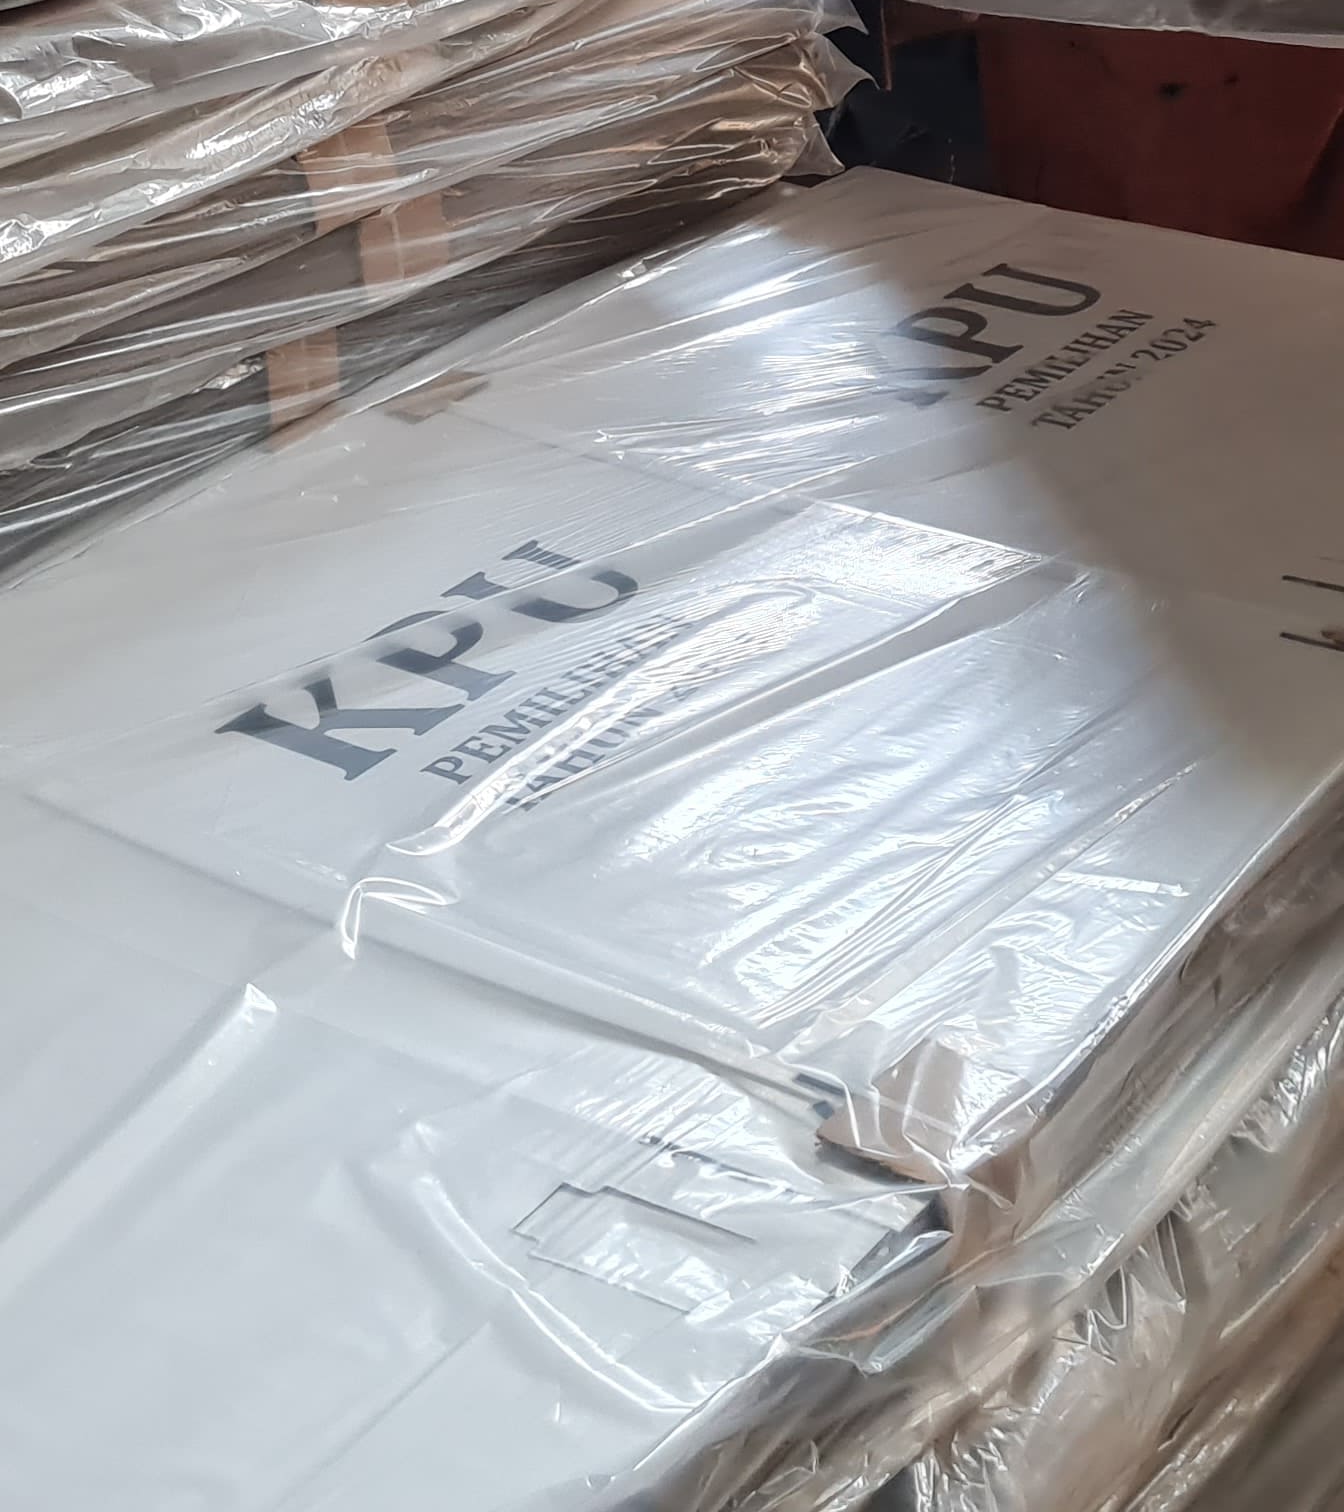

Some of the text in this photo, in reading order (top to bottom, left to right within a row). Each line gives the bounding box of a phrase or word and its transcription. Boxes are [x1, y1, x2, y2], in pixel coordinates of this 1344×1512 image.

[976, 308, 1154, 412] PEMILIHAN
[1130, 316, 1217, 362] 2024
[214, 539, 639, 781] KPU
